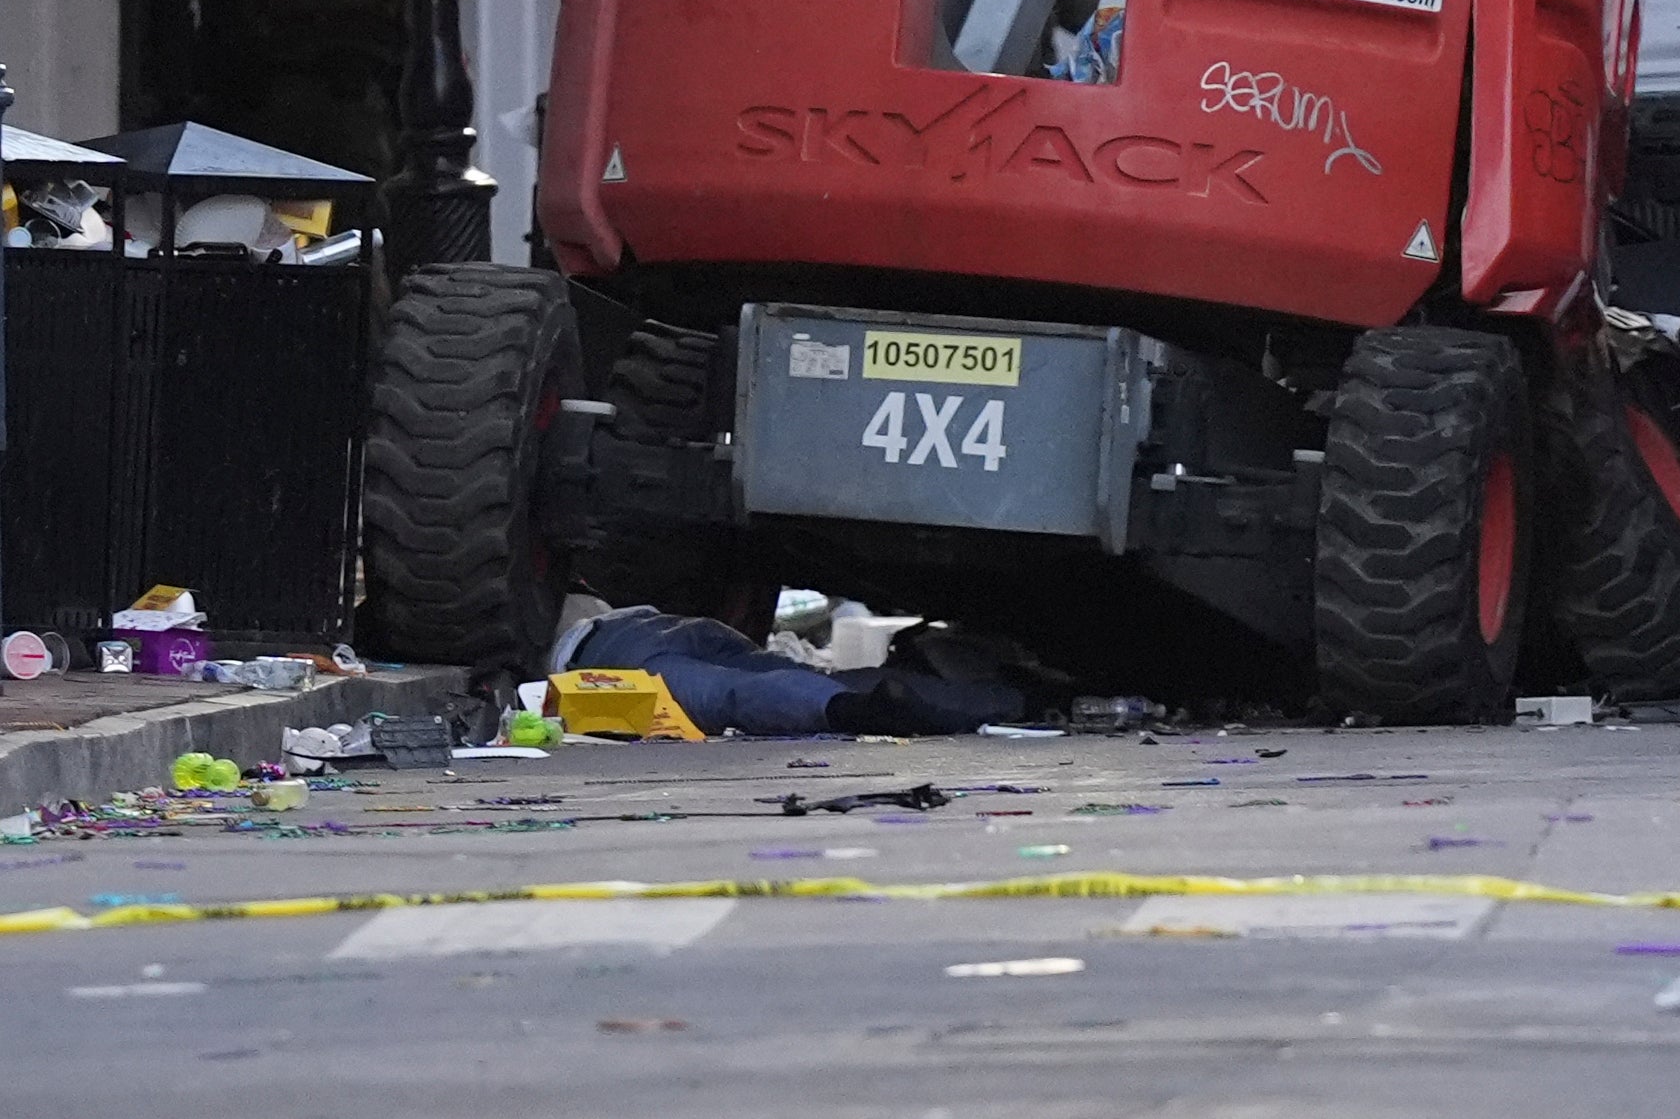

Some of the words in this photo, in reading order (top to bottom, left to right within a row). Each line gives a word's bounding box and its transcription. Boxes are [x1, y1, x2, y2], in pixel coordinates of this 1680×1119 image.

[736, 84, 1269, 206] SKYJACK
[866, 340, 1013, 372] 10507501
[862, 391, 1006, 471] 4X4
